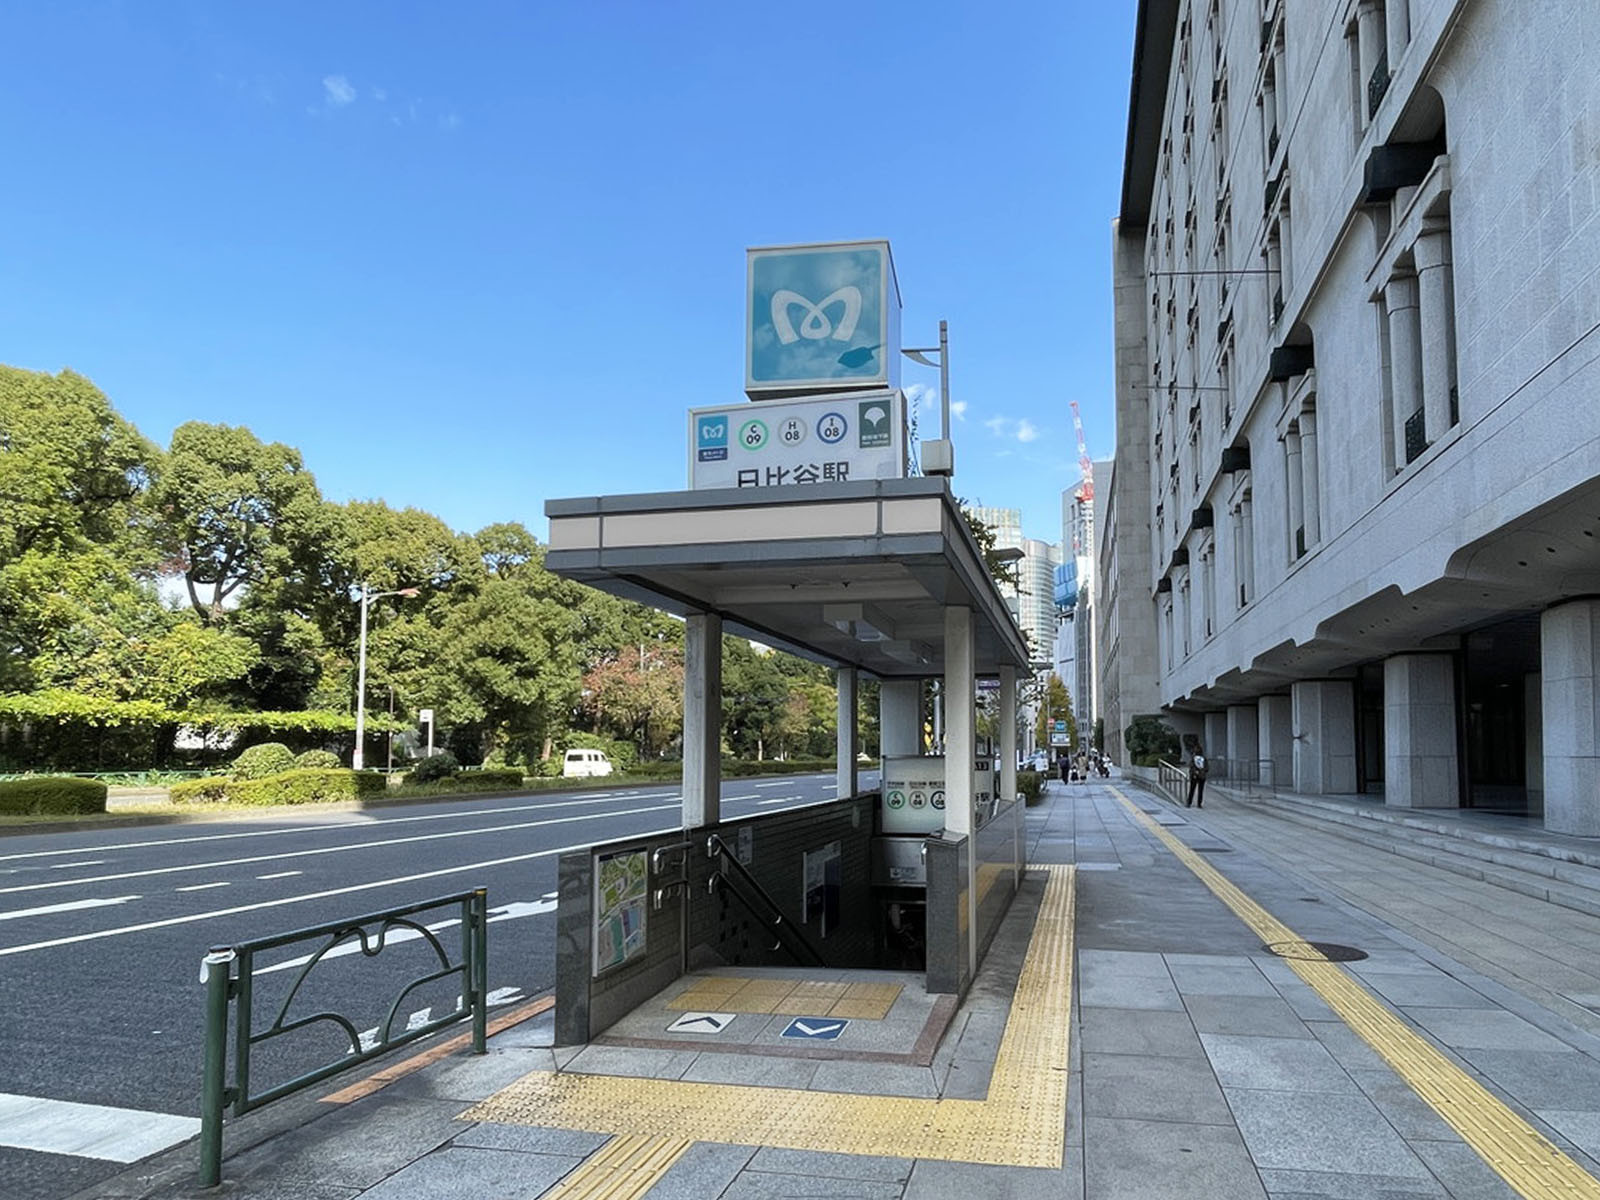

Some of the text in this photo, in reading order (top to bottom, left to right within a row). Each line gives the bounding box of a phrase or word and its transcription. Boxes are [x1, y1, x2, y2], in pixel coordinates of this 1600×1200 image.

[750, 425, 757, 434] C
[788, 422, 797, 430] H
[784, 431, 800, 442] 08
[824, 427, 840, 438] 08
[746, 434, 761, 445] 09
[737, 461, 849, 488] 日比谷駅
